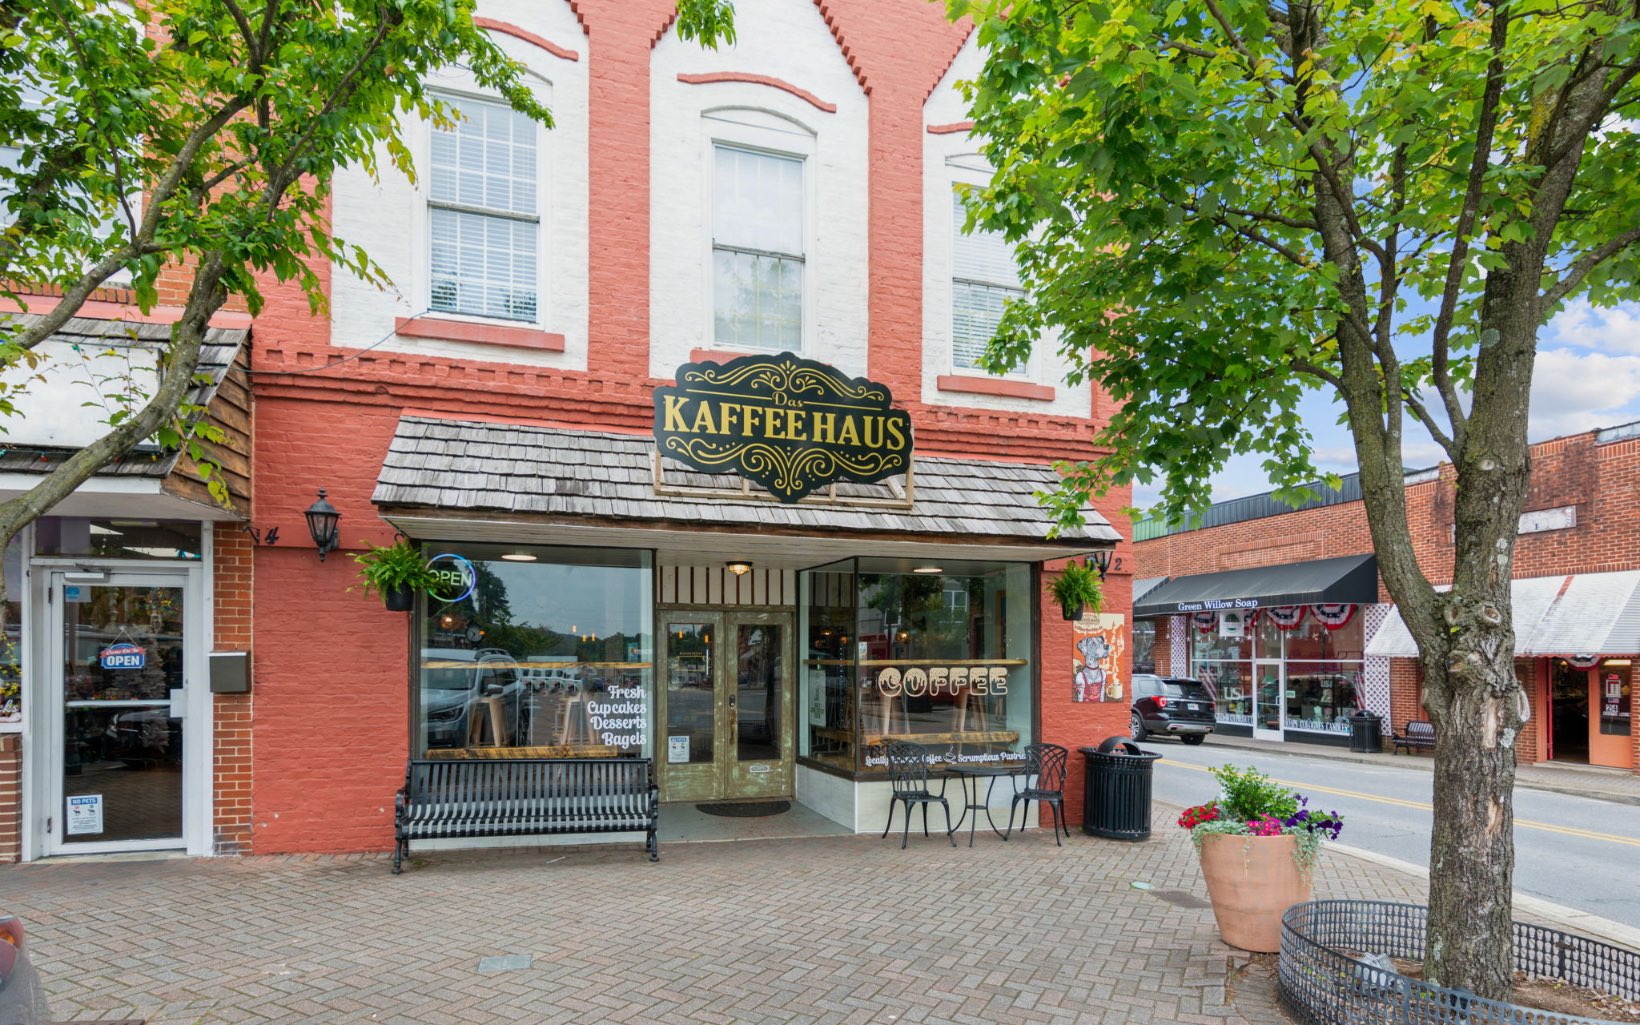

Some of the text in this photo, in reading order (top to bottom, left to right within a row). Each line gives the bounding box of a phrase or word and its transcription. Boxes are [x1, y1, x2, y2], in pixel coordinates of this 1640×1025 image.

[772, 391, 804, 408] Das
[663, 394, 906, 451] KAFFEE HAUS
[1114, 557, 1123, 571] 2
[1177, 598, 1258, 611] Green Willow Soap
[106, 655, 140, 667] OPEN
[878, 667, 1009, 697] COFFEE
[607, 684, 647, 699] Fresh
[587, 700, 647, 718] Cupcakes
[590, 716, 647, 730] Desserts
[601, 731, 647, 750] Bagels
[865, 755, 889, 767] Locally
[957, 751, 1000, 763] Scrumptious
[1000, 750, 1027, 761] Pastrie
